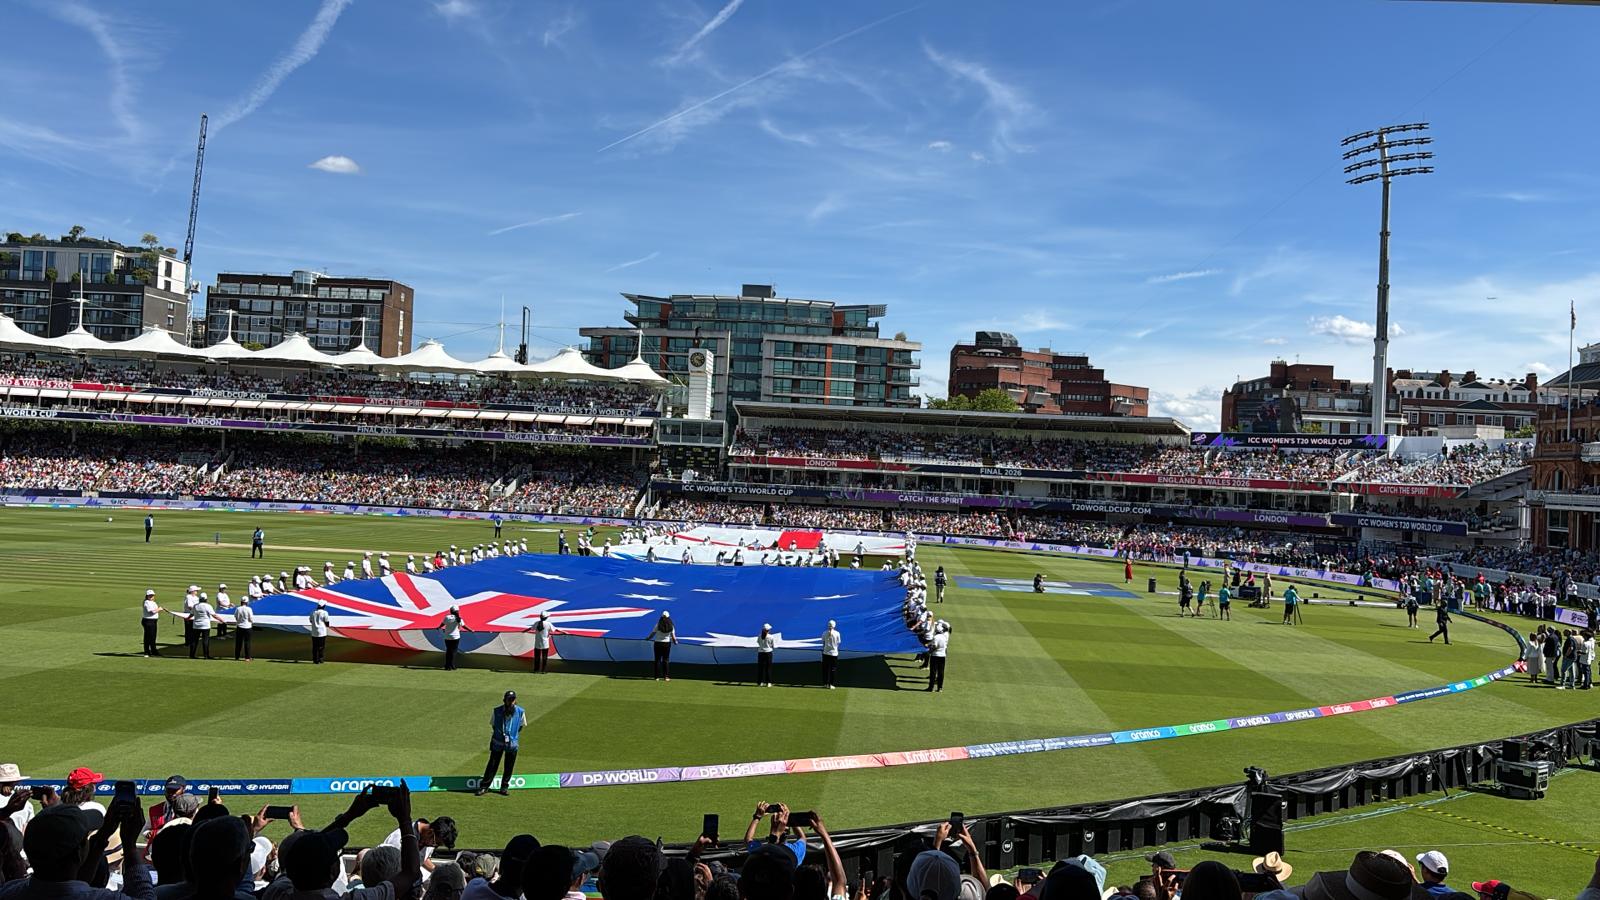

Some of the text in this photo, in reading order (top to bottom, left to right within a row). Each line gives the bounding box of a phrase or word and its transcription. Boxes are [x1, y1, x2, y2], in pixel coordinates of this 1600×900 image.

[14, 379, 20, 387] &
[53, 382, 74, 390] 2026
[190, 389, 267, 400] T20WORLDCUP.COM
[364, 398, 388, 406] CATCH
[4, 408, 58, 418] WORLD CUP
[548, 406, 583, 414] WOMEN'S
[600, 408, 625, 416] WORLD
[187, 418, 222, 426] LONDON
[357, 425, 397, 434] FINAL 2026
[504, 432, 539, 441] ENGLAND
[574, 435, 590, 443] 2026
[1338, 438, 1352, 446] CUP
[1158, 476, 1195, 485] ENGLAND
[1204, 478, 1231, 486] WALES
[1232, 479, 1250, 487] 2026
[682, 484, 794, 496] ICC WOMEN'S T20 WORLD CUP
[1379, 486, 1429, 495] CATCH THE SPIRIT
[898, 494, 924, 503] CATCH
[941, 497, 964, 505] SPIRIT
[1072, 504, 1151, 514] T20WORLDCUP.COM
[1254, 514, 1288, 524] LONDON
[1358, 518, 1369, 526] ICC
[1370, 520, 1399, 529] WOMEN'S
[1411, 522, 1430, 532] WORLD
[1431, 524, 1443, 533] CUP
[1189, 724, 1215, 733] aramco
[1130, 730, 1160, 740] aramco
[906, 750, 948, 763] Emirates
[700, 768, 719, 777] DP
[583, 772, 658, 785] DP WORLD
